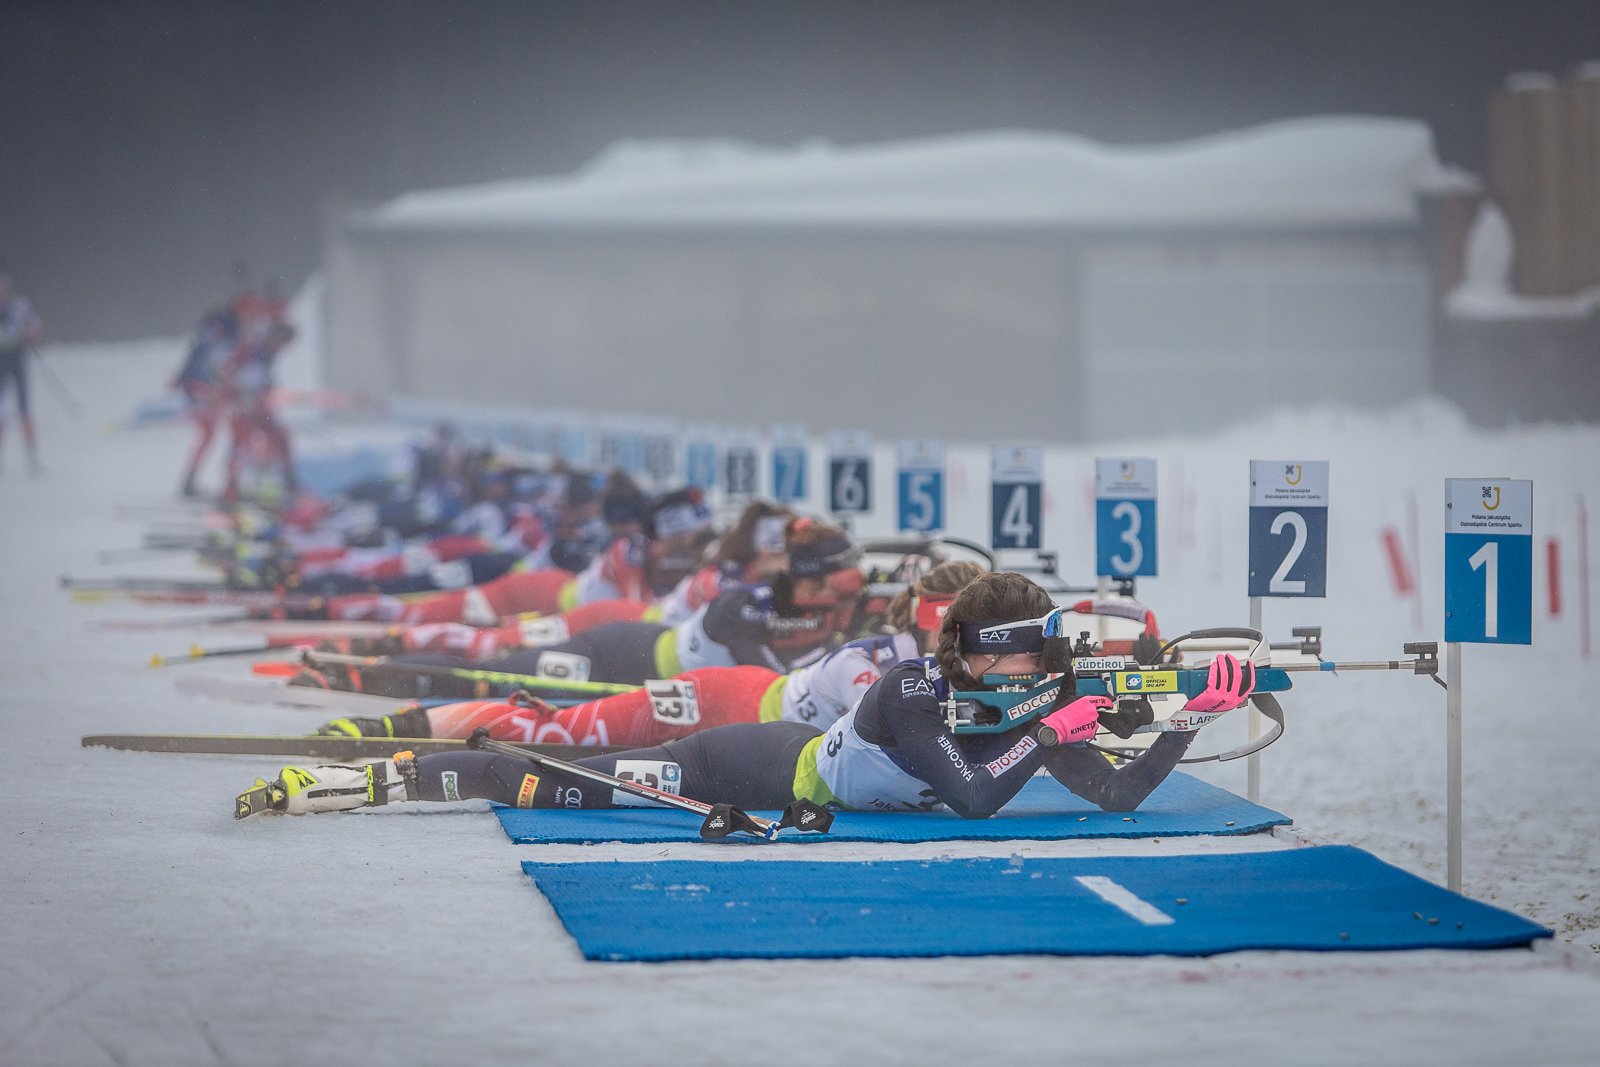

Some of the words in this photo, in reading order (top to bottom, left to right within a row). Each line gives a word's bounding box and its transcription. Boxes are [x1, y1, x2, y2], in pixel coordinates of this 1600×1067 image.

[835, 459, 865, 509] 6
[906, 474, 934, 529] 5
[1003, 485, 1033, 547] 4
[1110, 501, 1144, 575] 3
[1269, 511, 1308, 593] 2
[1468, 542, 1498, 638] 1
[980, 630, 1011, 640] EA7
[650, 685, 682, 719] 13
[827, 731, 843, 758] 3
[936, 734, 974, 782] FALCONER
[988, 737, 1035, 774] FIOCCHI
[444, 773, 457, 801] FORS
